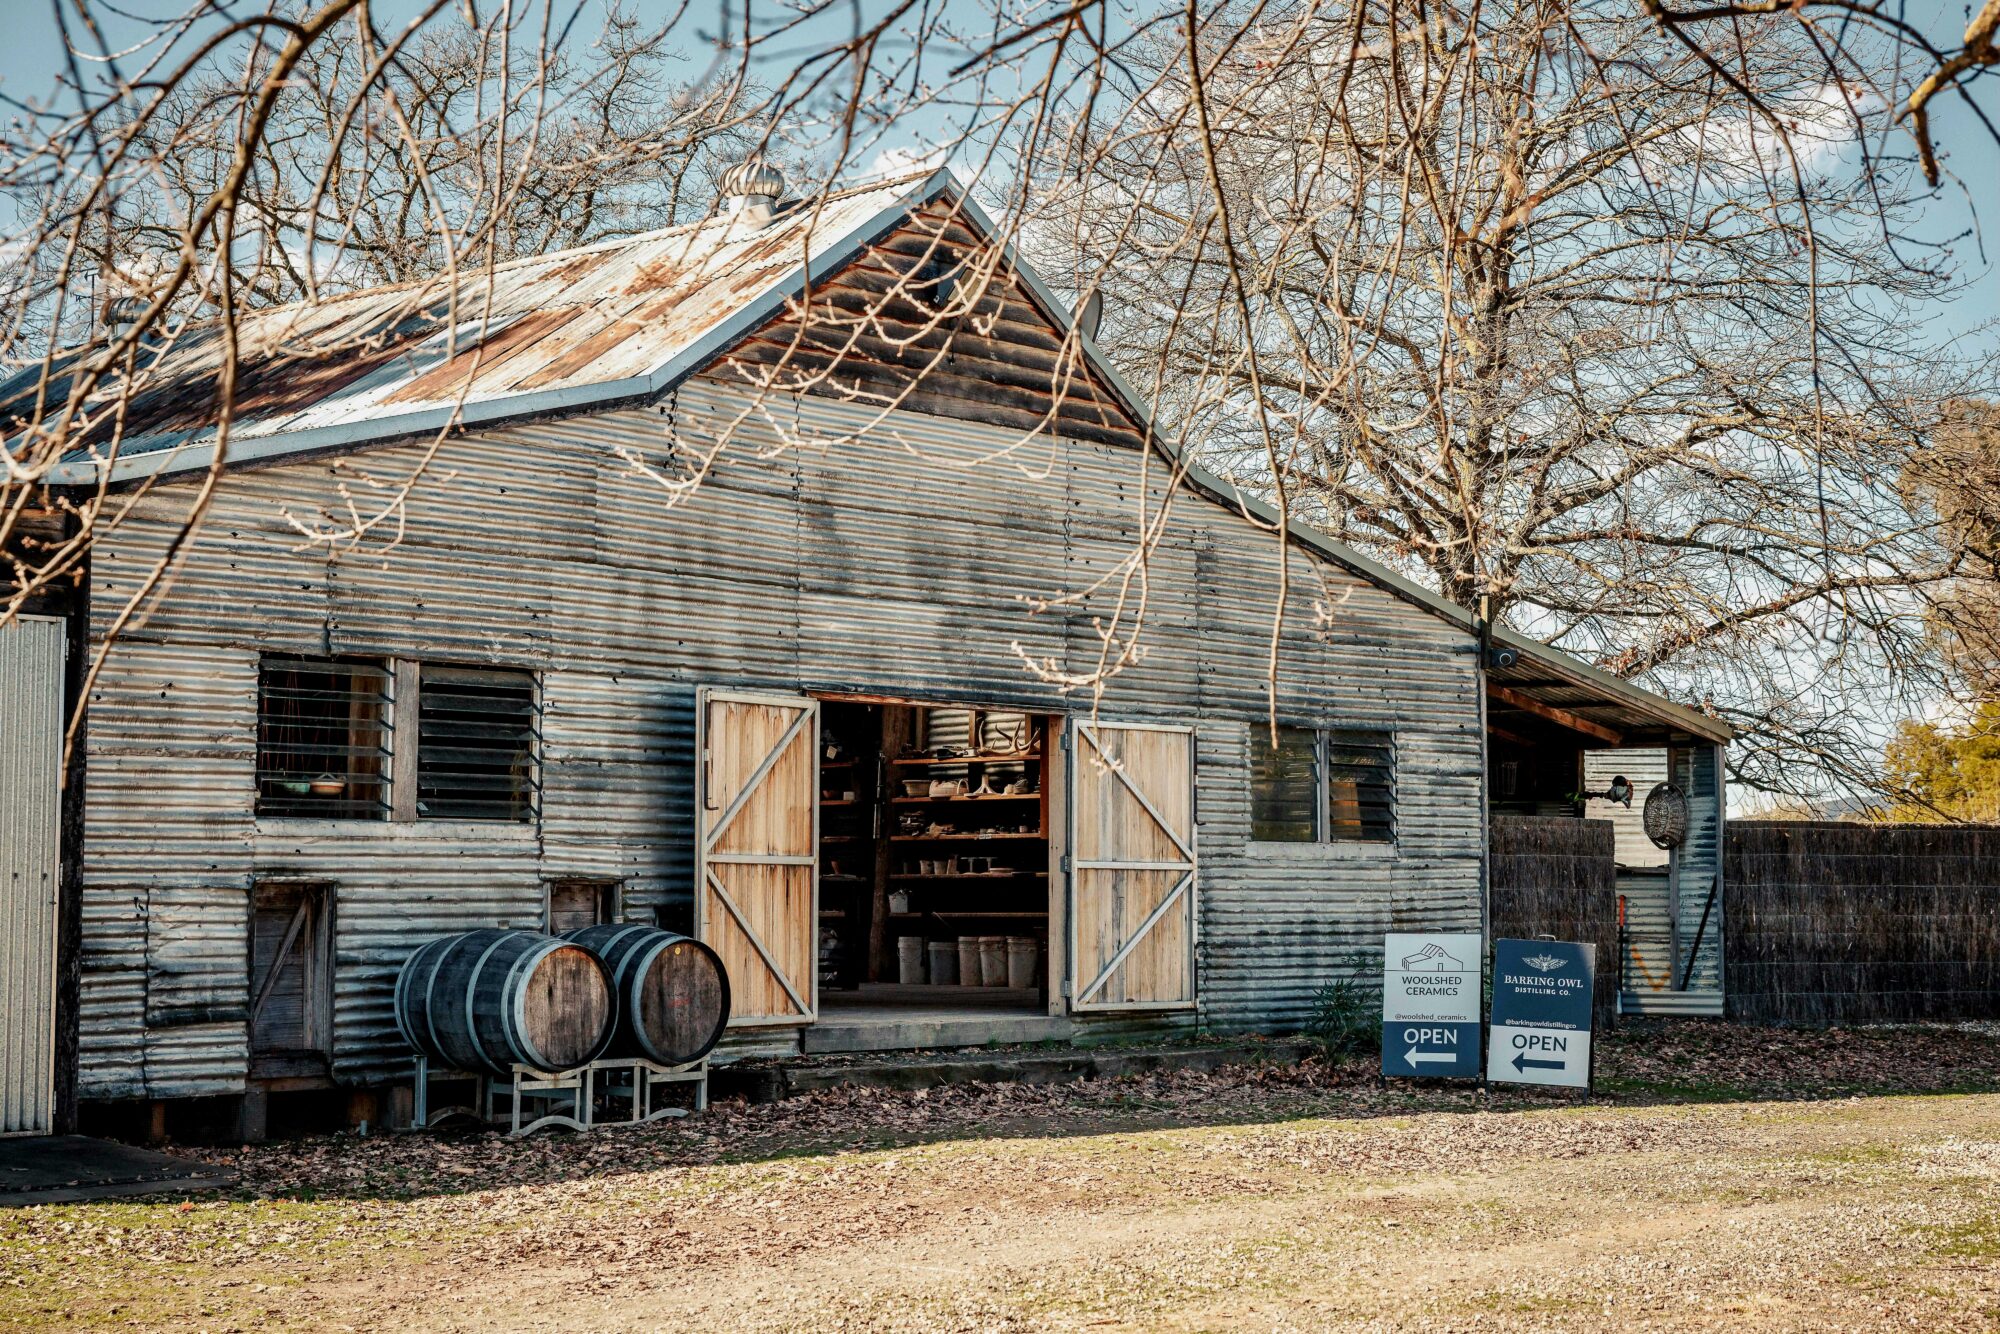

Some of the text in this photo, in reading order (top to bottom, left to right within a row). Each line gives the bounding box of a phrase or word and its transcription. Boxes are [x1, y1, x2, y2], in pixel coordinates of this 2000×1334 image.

[1402, 976, 1462, 985] WOOLSHED
[1504, 975, 1584, 988] BARKING OWL
[1406, 987, 1458, 996] CERAMICS
[1515, 987, 1556, 995] DISTILLING
[1395, 1013, 1467, 1022] @woolshed_ceramics
[1505, 1019, 1577, 1029] @barkingowldistillingco
[1404, 1028, 1457, 1044] OPEN
[1512, 1034, 1567, 1051] OPEN
